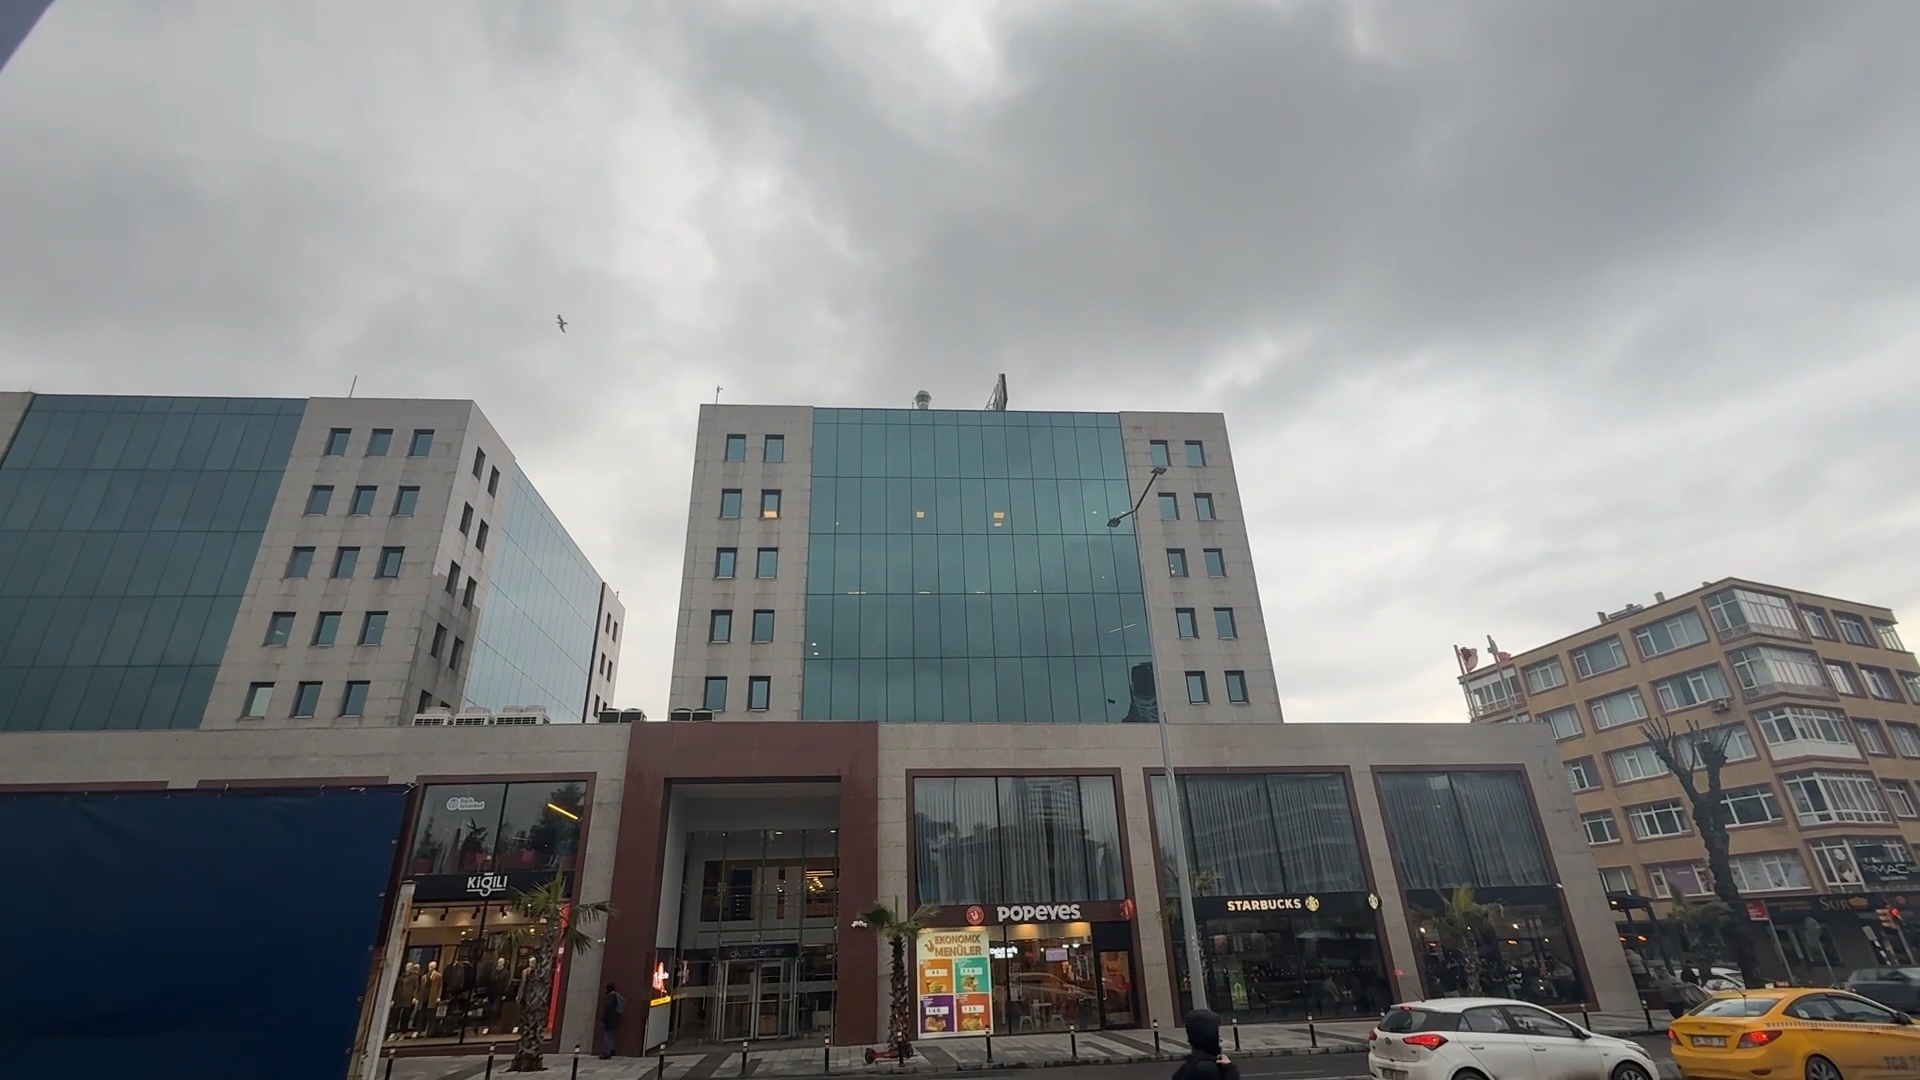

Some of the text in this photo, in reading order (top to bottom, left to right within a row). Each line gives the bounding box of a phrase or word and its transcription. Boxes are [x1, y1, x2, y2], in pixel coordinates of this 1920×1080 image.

[1226, 898, 1302, 912] STARBUCKS
[934, 934, 981, 944] EKONOMIX
[934, 945, 982, 957] MENÜLER
[1883, 1055, 1909, 1070] TCS
